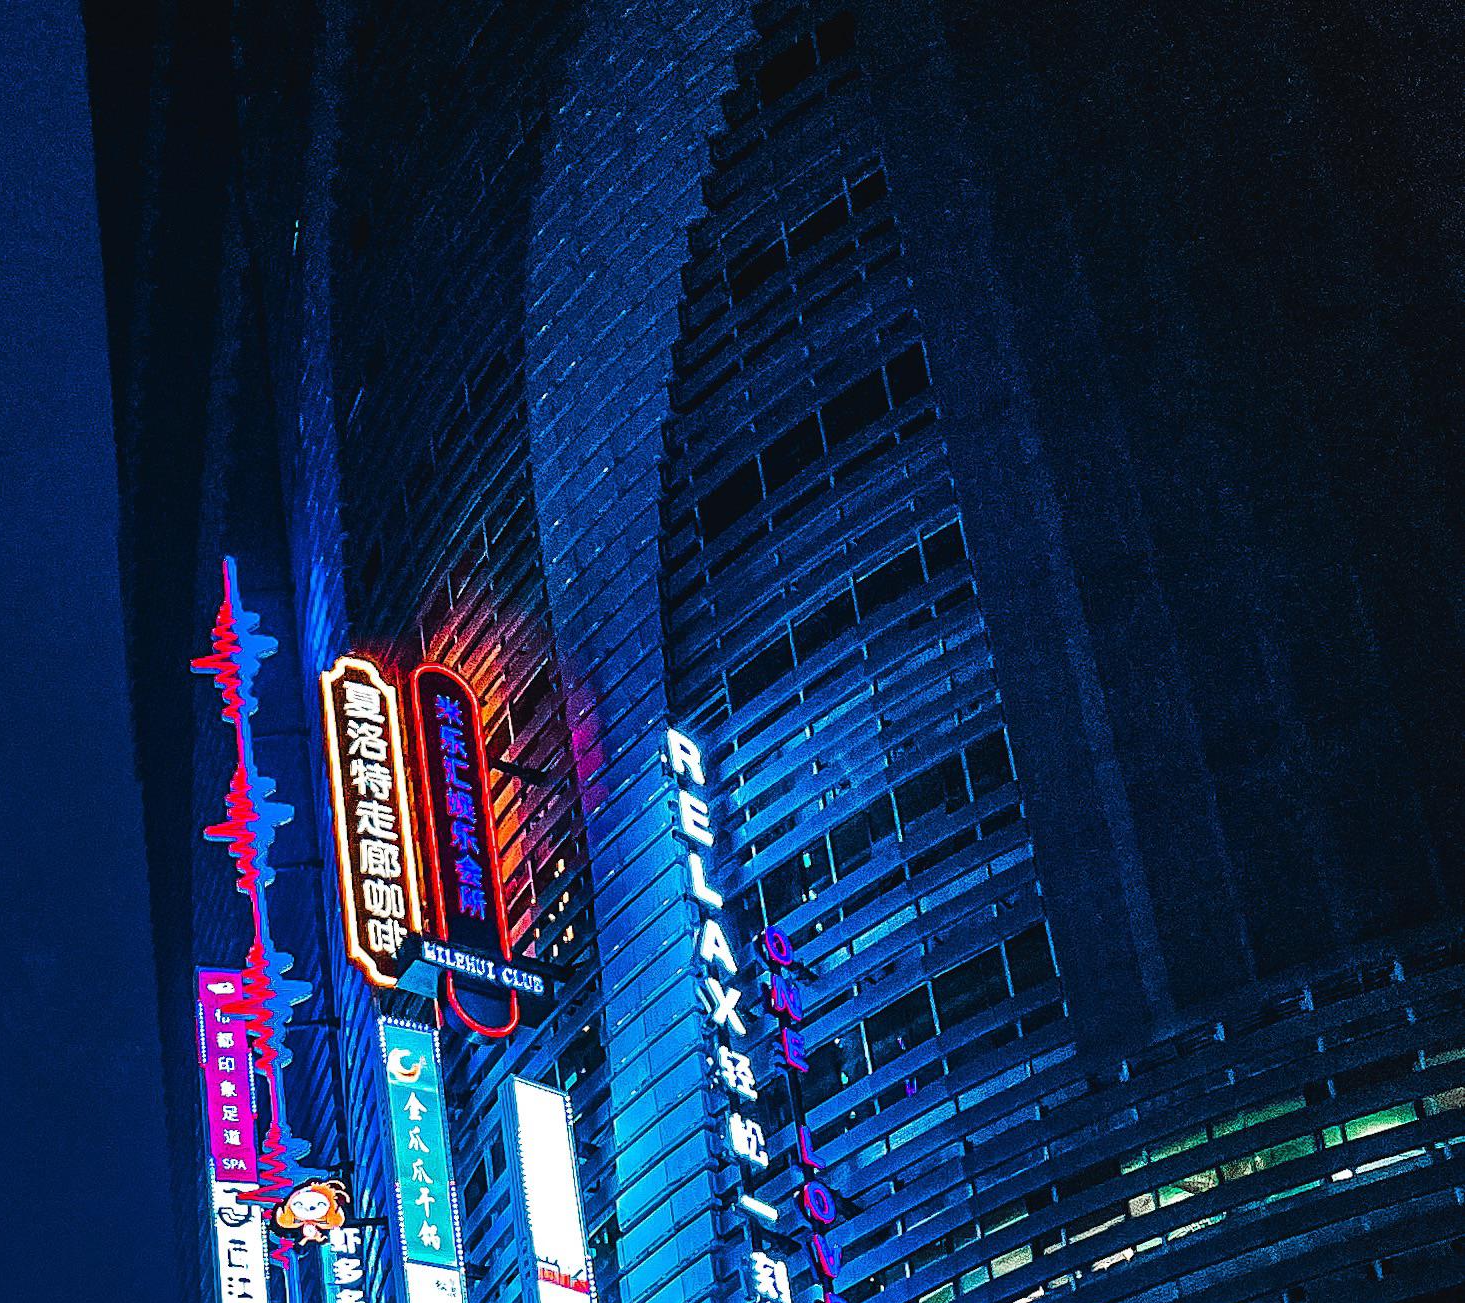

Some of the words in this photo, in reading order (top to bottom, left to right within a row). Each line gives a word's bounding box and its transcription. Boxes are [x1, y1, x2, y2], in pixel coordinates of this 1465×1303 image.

[343, 681, 408, 959] 夏洛特走廊咖啡
[666, 727, 747, 1036] RELAX
[501, 965, 545, 994] CLUB
[765, 925, 808, 1073] ONE
[221, 1158, 247, 1170] SPA
